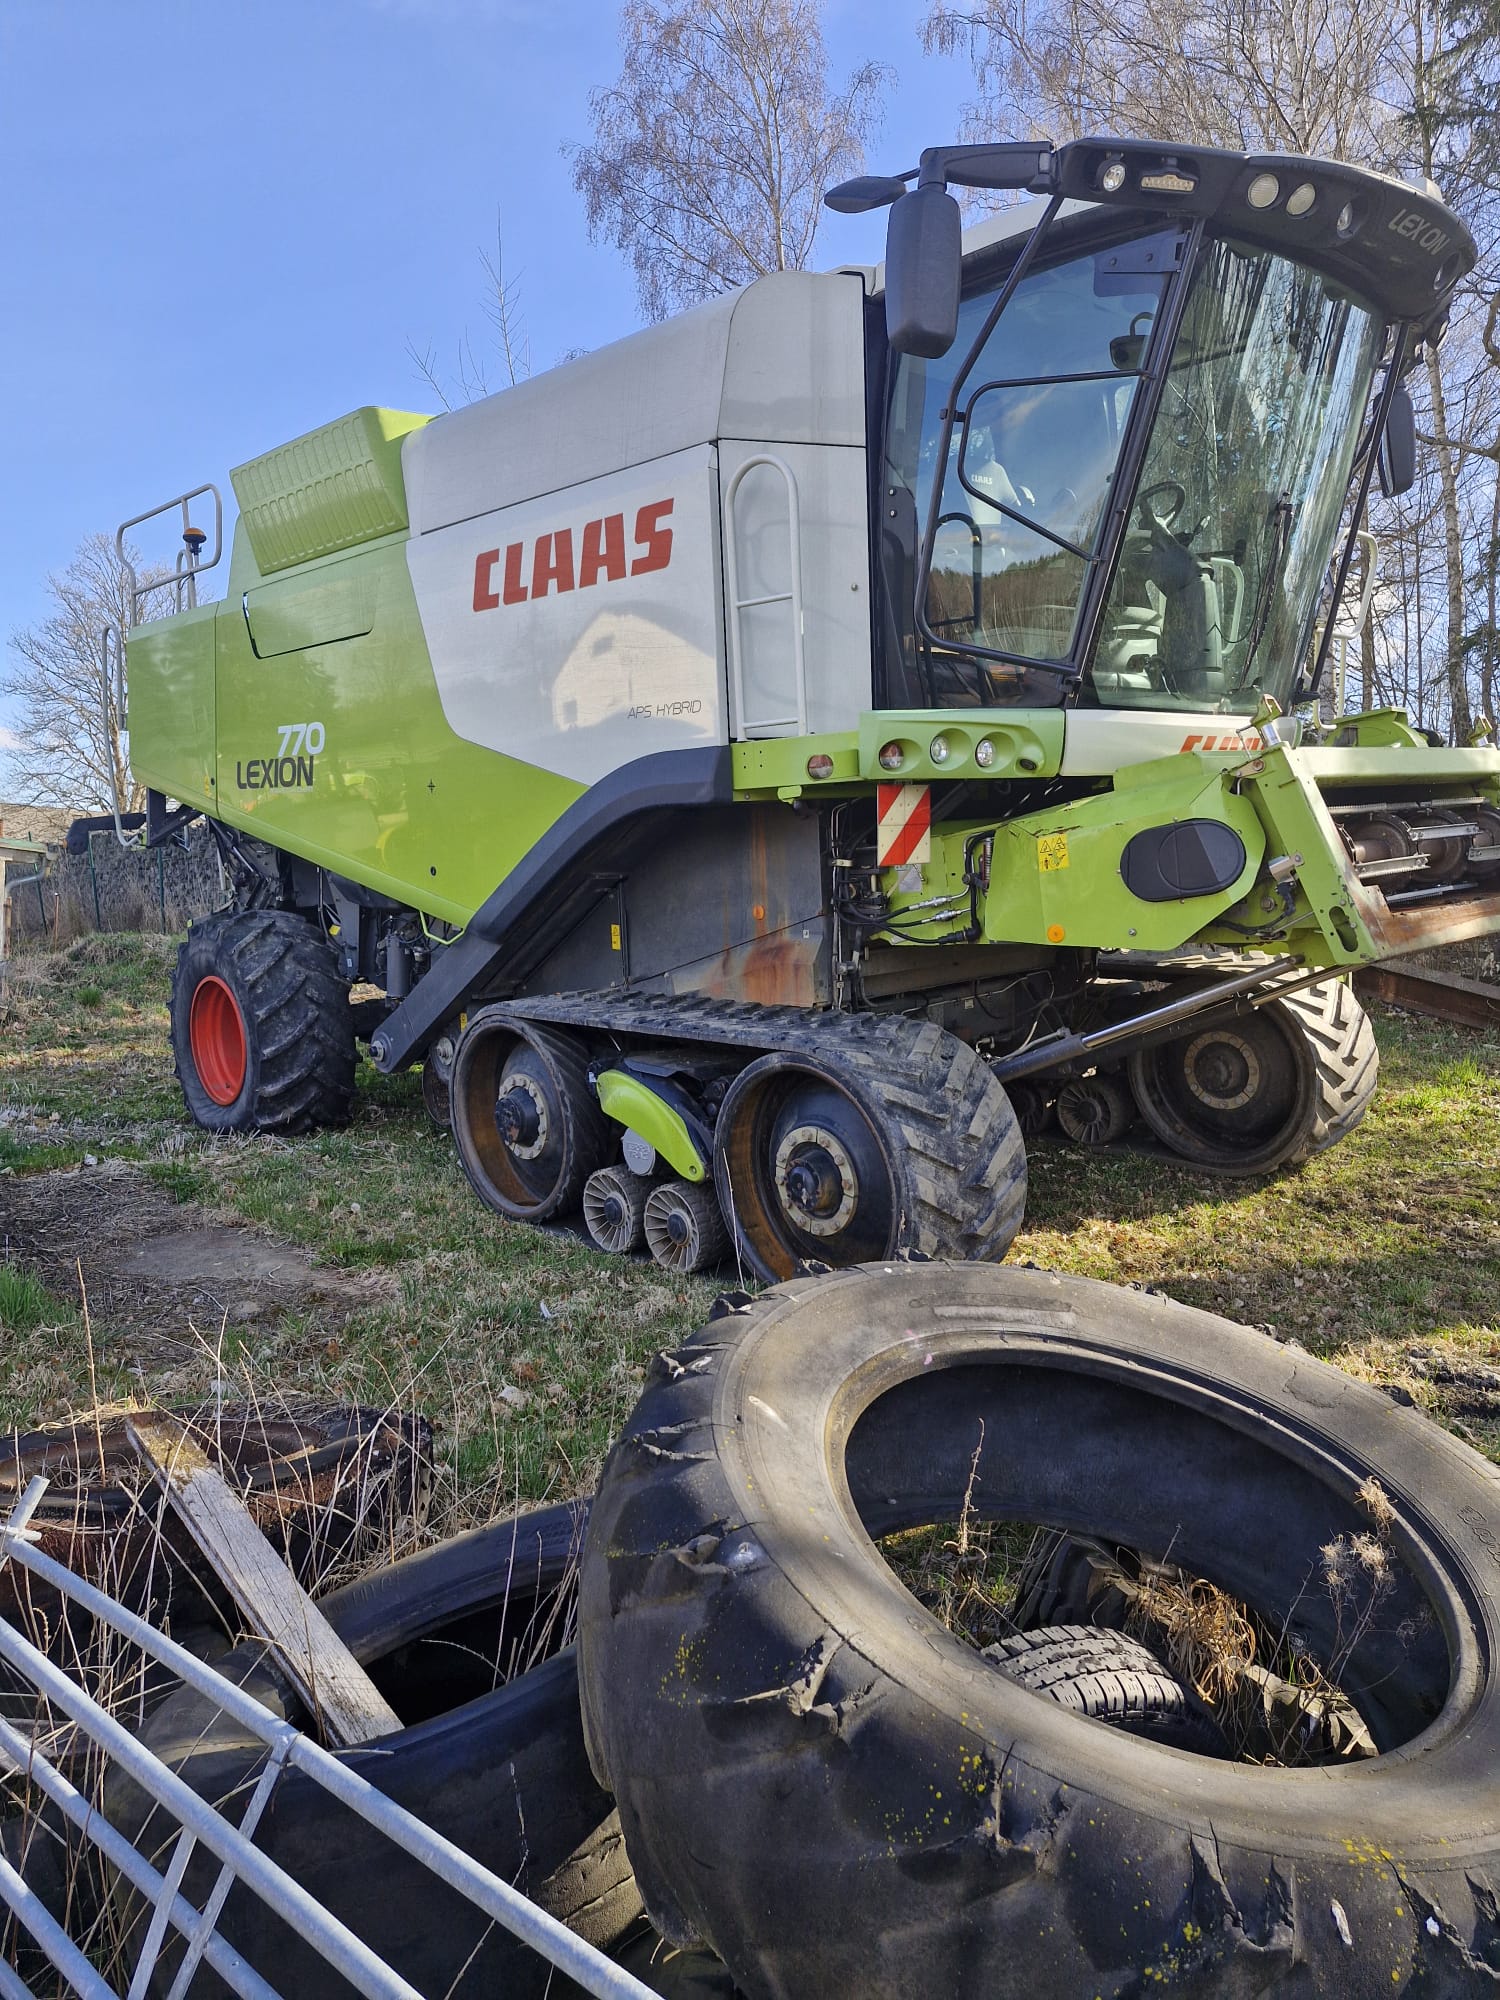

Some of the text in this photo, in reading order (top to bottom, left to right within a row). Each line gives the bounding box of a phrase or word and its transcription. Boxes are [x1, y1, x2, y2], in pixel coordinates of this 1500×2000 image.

[473, 497, 674, 613] CLAAS
[627, 699, 702, 719] APS HYBRID
[277, 721, 326, 758] 770
[236, 755, 314, 789] LEXION
